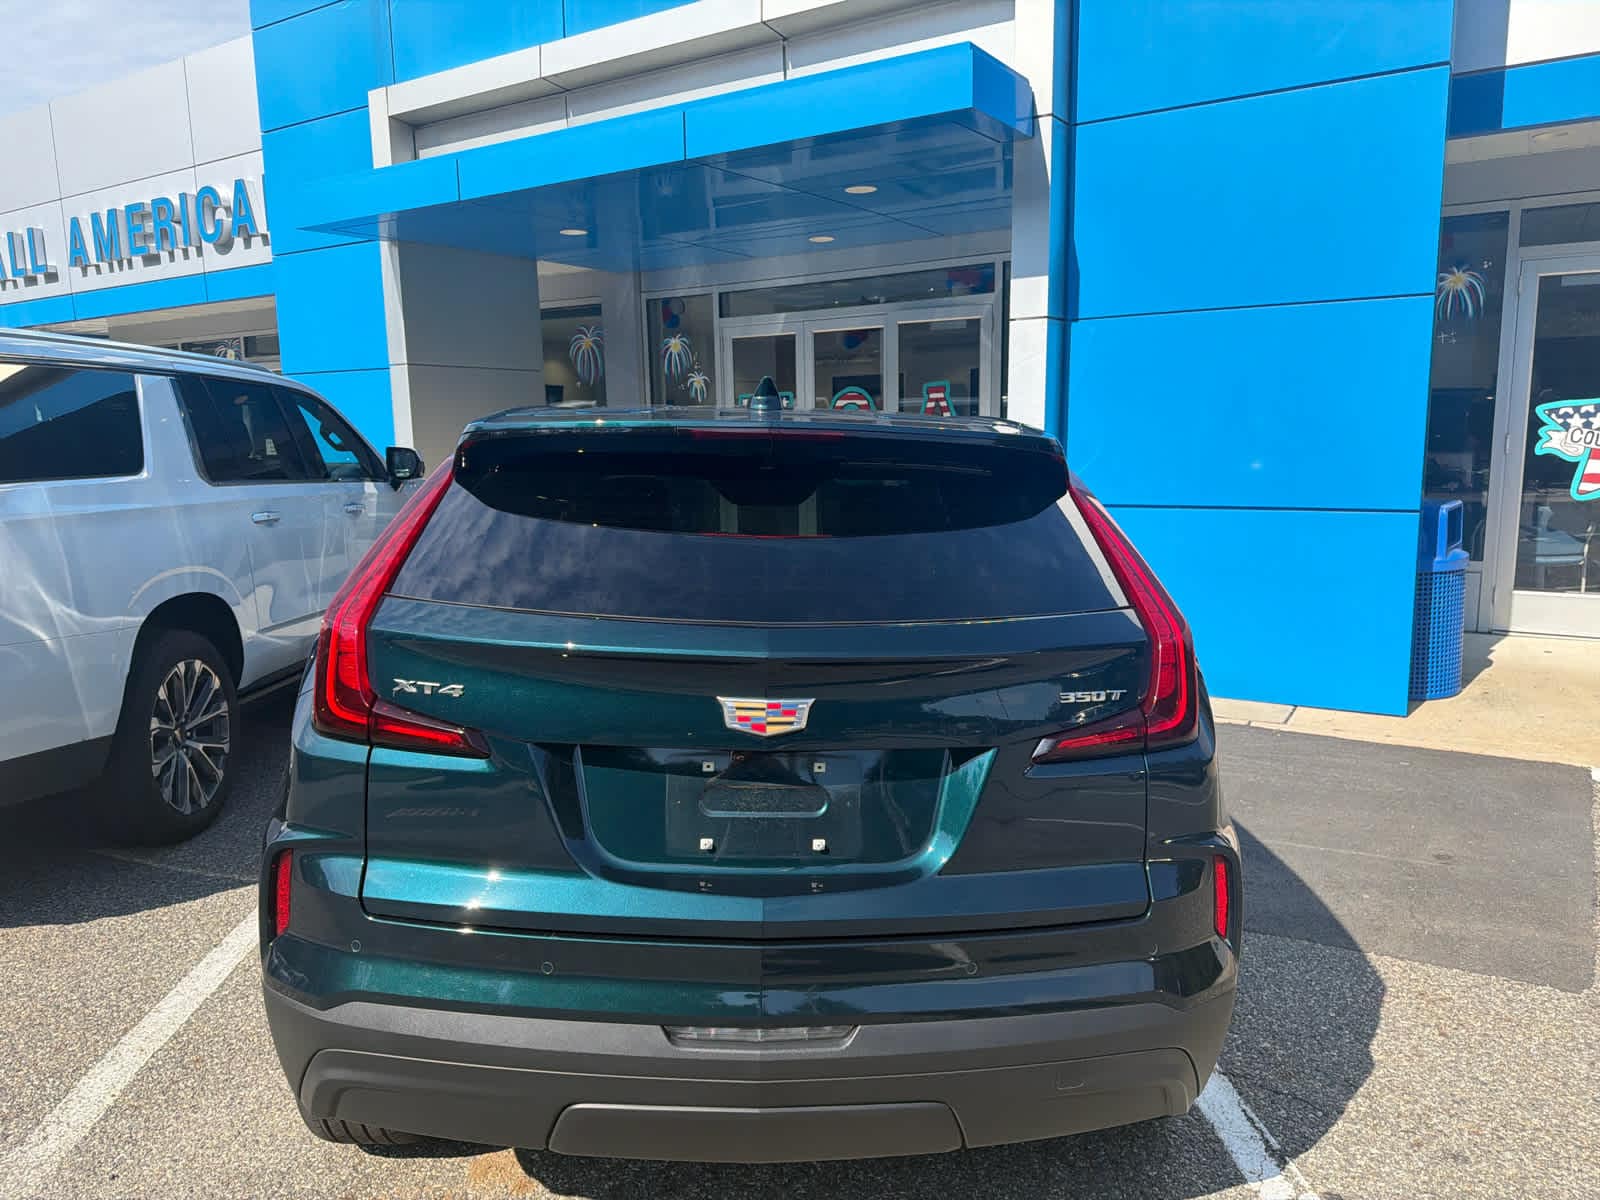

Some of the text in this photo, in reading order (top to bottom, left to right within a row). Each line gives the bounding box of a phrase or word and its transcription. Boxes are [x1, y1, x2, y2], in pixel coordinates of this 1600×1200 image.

[68, 174, 270, 267] AMERICA
[392, 678, 464, 697] XT4
[1060, 689, 1127, 704] 350T
